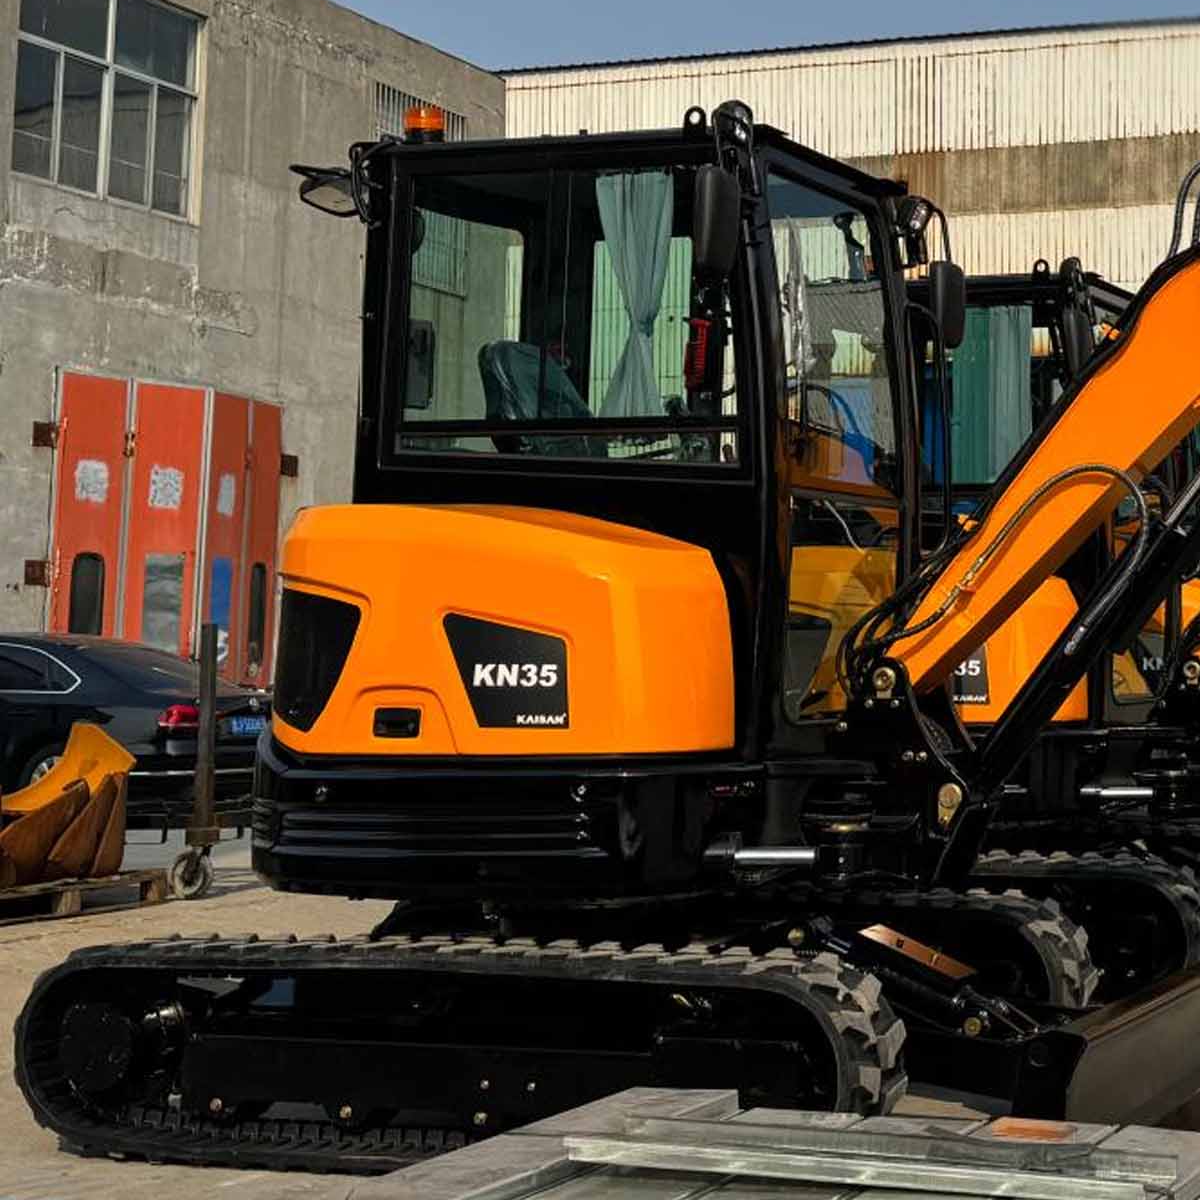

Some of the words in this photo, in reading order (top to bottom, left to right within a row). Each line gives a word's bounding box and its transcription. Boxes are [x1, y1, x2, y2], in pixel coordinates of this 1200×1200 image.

[472, 663, 558, 687] KN35
[953, 660, 981, 676] 35
[515, 714, 565, 725] KAISAN
